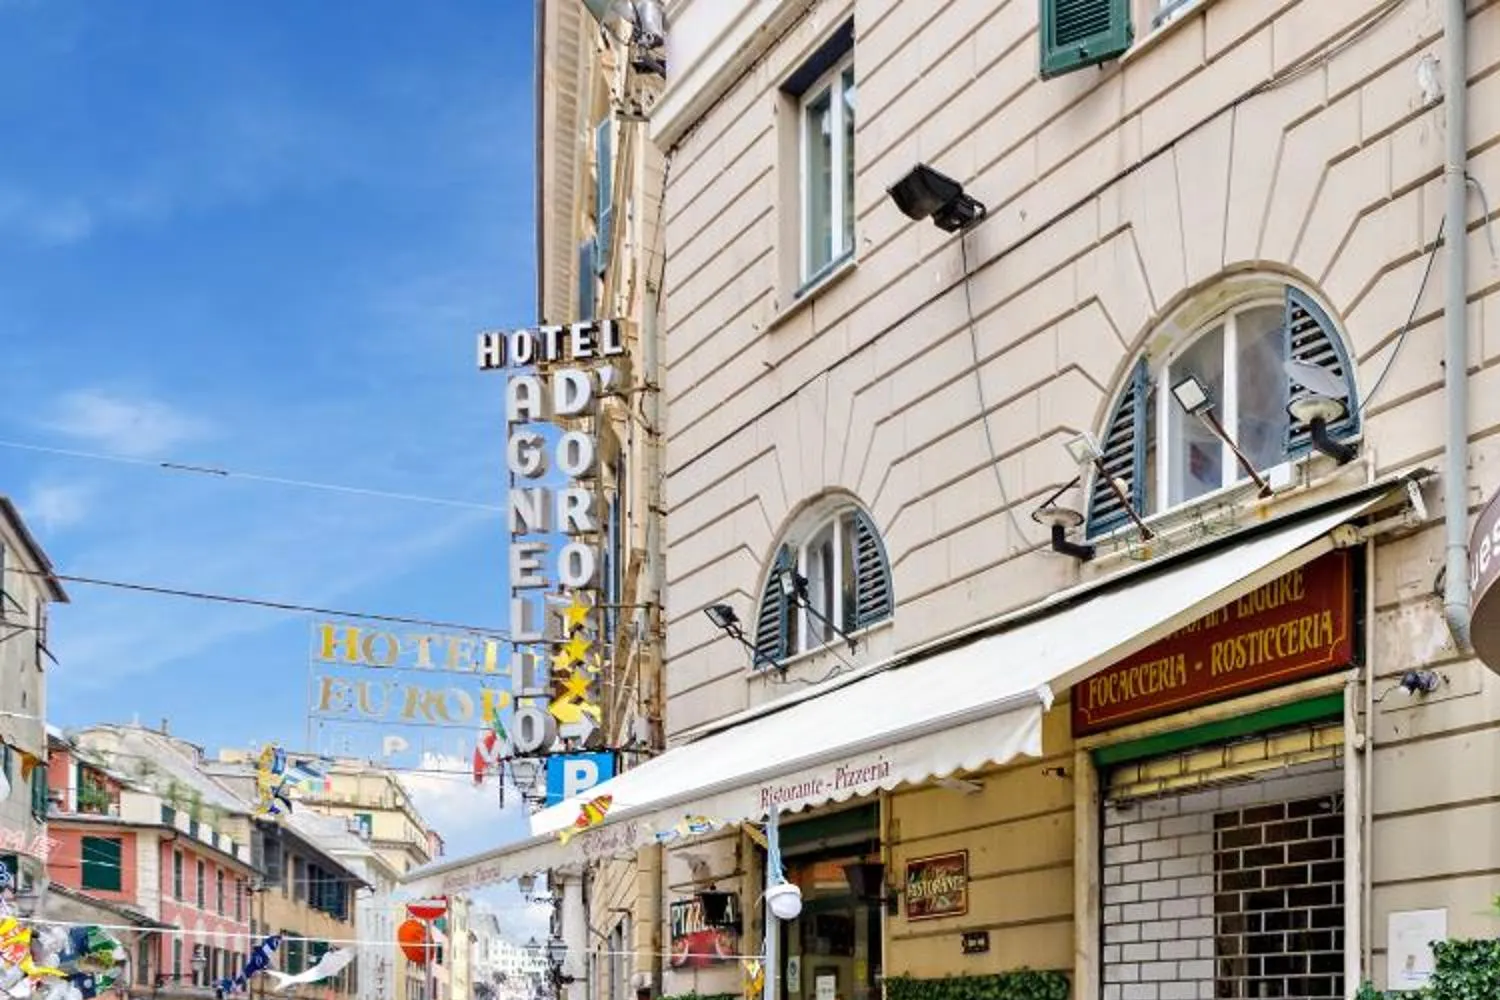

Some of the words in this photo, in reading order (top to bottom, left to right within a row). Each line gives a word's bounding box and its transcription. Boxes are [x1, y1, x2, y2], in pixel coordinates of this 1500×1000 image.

[476, 319, 624, 369] HOTEL
[506, 374, 552, 753] AGNELLO
[318, 621, 513, 675] HOTEL
[1088, 653, 1187, 710] FOCACCERIA
[1210, 609, 1333, 677] ROSTICCERIA
[318, 675, 514, 726] EUROP
[760, 777, 823, 809] Ristorante
[834, 754, 890, 791] Pizzeria
